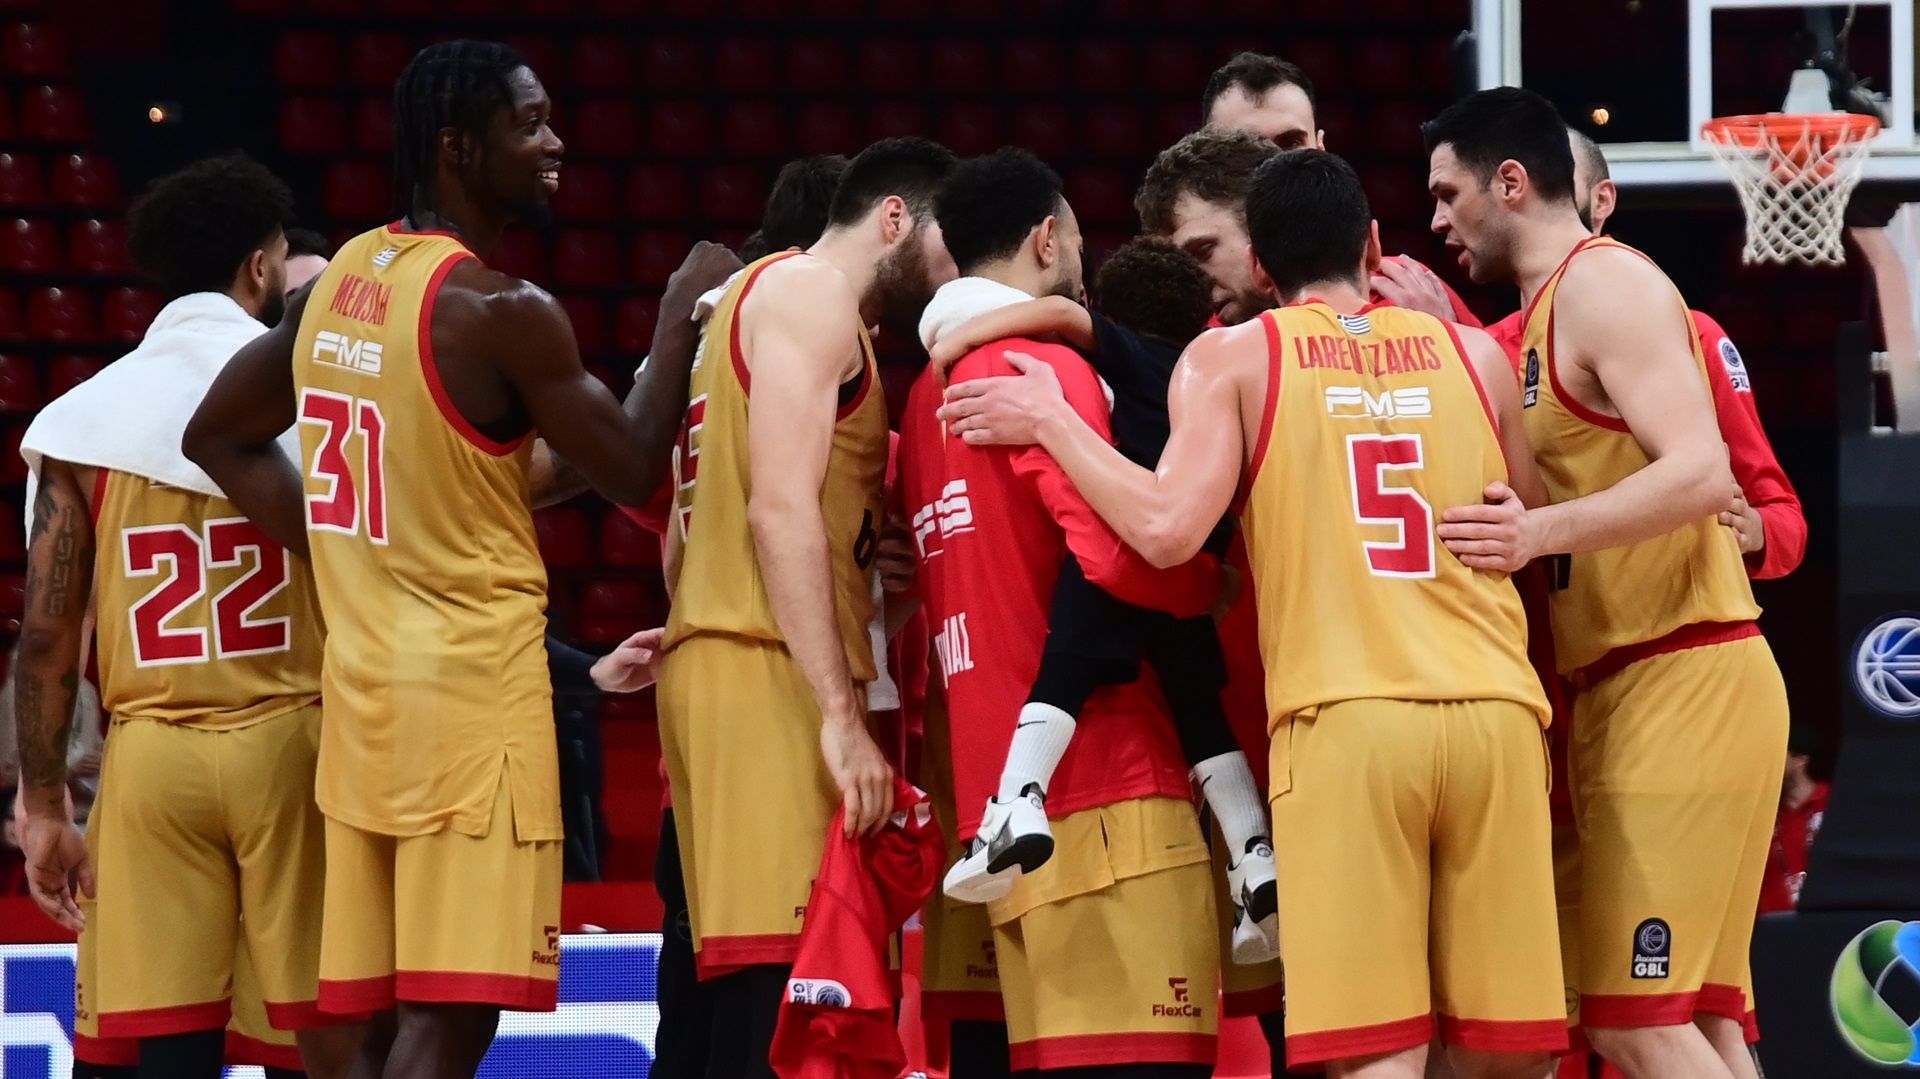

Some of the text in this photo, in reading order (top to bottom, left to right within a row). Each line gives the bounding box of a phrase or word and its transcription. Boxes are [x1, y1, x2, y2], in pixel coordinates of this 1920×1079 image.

[313, 330, 383, 375] FMS
[1294, 335, 1441, 378] LARENZAKIS
[1325, 386, 1432, 416] FMS
[298, 387, 389, 546] 31
[1346, 433, 1437, 579] 5
[122, 516, 290, 668] 22
[1635, 963, 1666, 977] GBL
